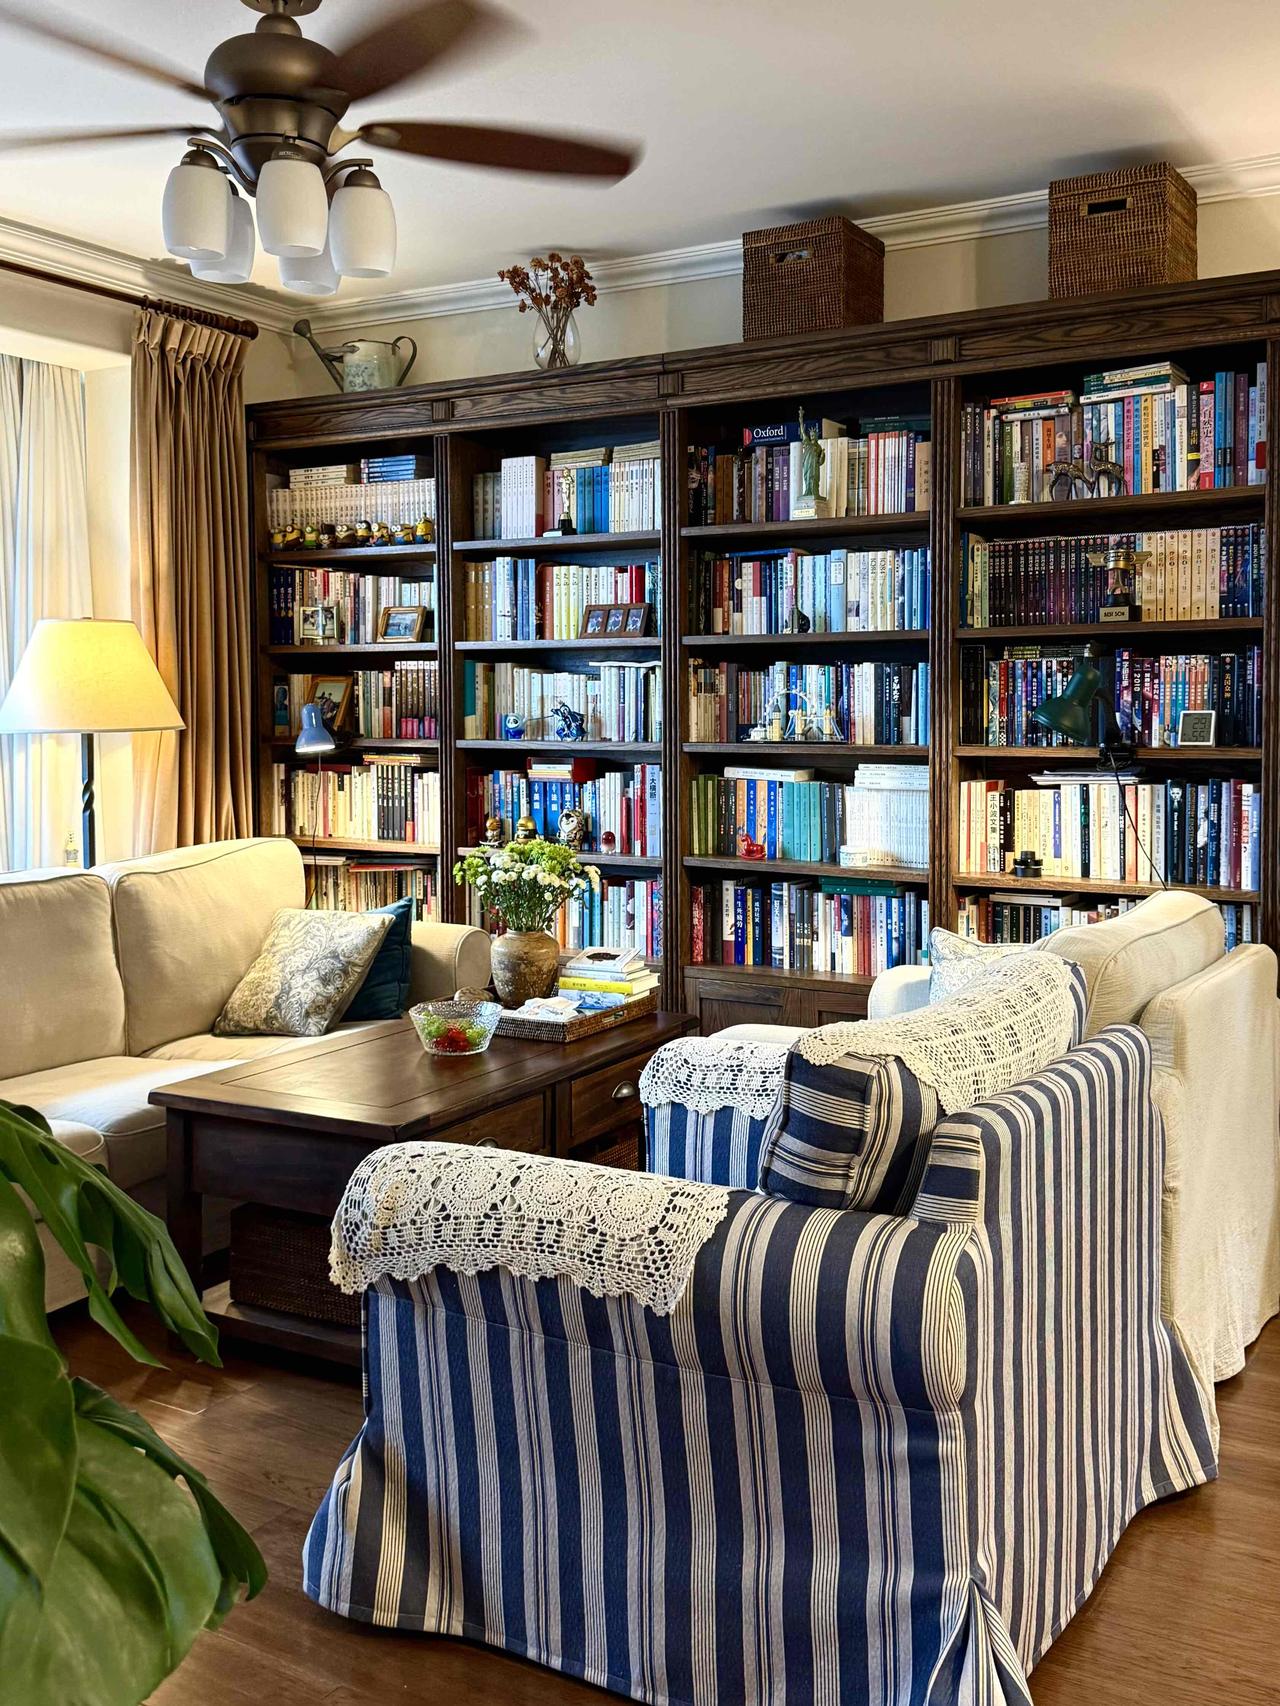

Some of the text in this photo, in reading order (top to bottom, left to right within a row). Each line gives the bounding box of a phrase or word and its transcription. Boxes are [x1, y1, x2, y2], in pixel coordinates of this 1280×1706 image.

[753, 425, 784, 438] Oxford
[1133, 672, 1141, 692] 2010
[990, 794, 998, 834] 王小波文集
